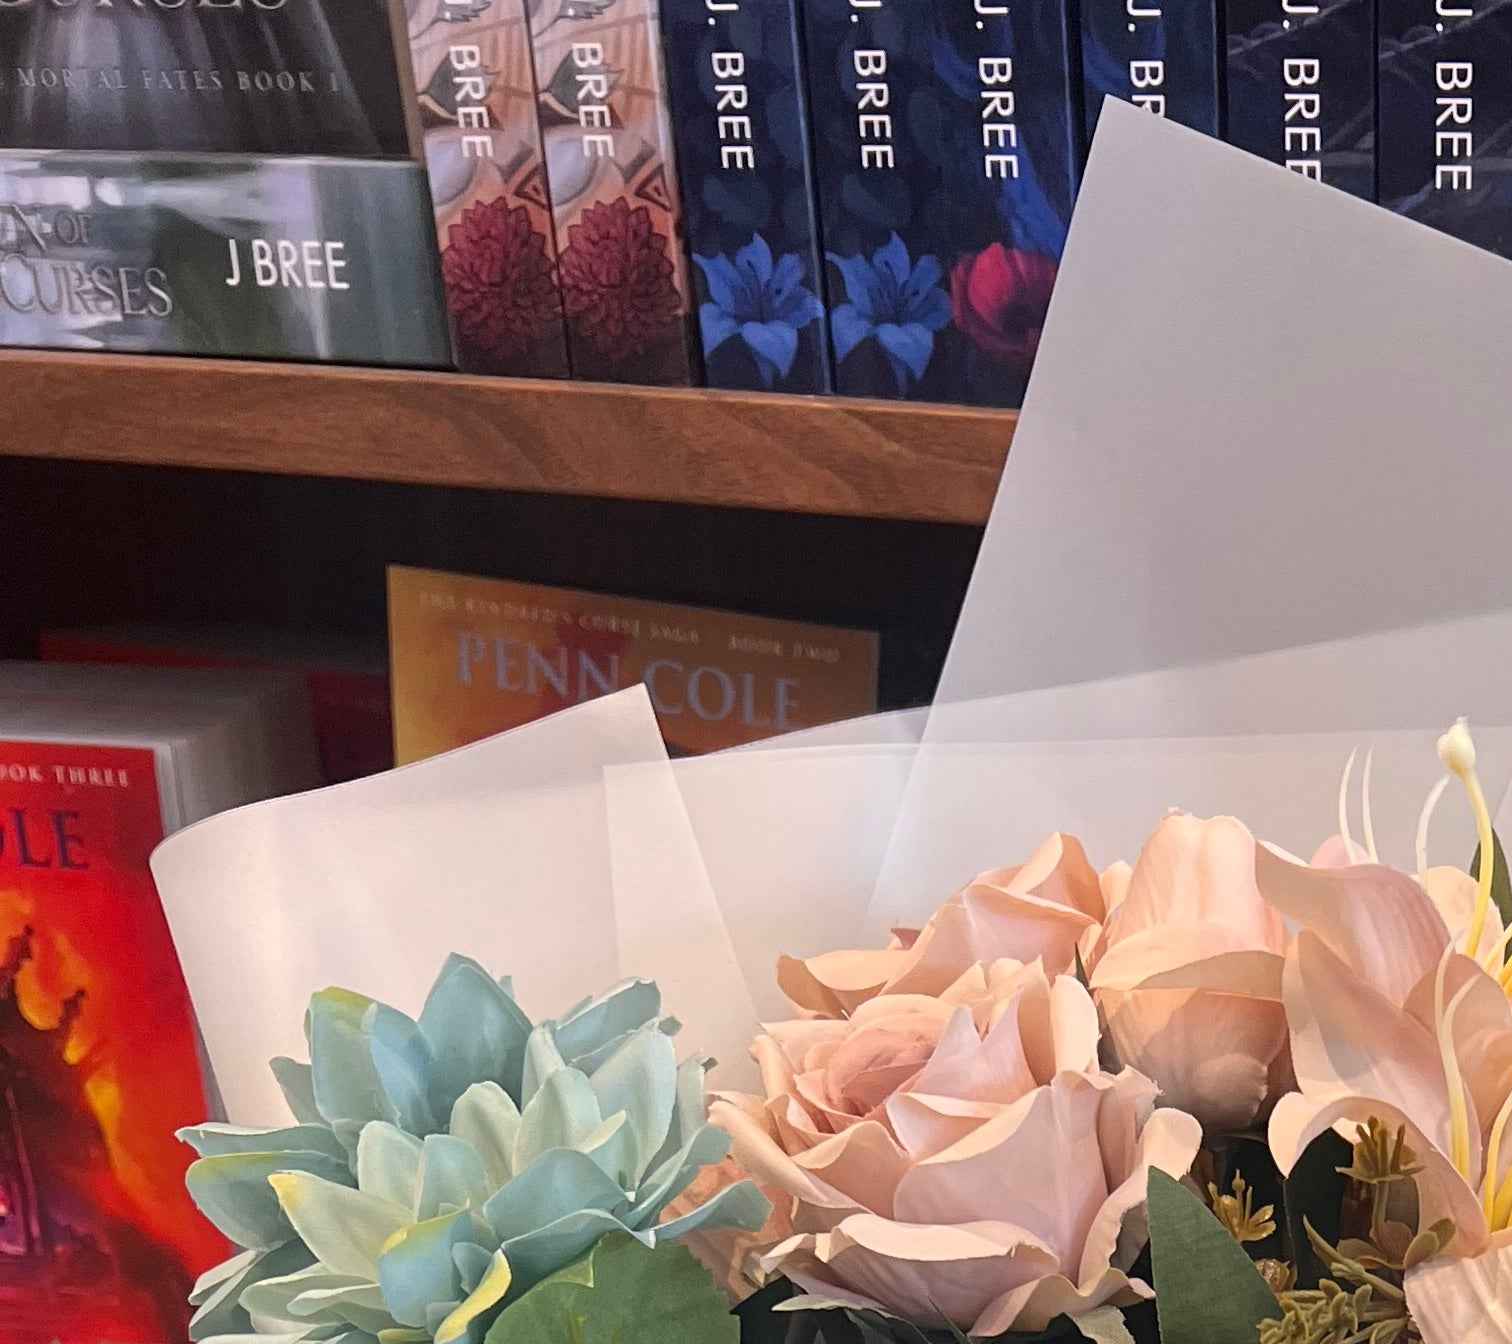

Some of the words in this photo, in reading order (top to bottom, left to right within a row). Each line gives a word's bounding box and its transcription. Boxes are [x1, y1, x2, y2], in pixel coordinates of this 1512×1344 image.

[18, 67, 128, 90] MORTAL
[238, 71, 315, 92] BOOK
[449, 44, 495, 159] BREE
[572, 42, 615, 158] BREE
[711, 51, 755, 169] BREE
[853, 49, 895, 169] BREE
[978, 57, 1018, 179] BREE
[1435, 61, 1473, 190] BREE
[0, 252, 173, 318] CURSES
[226, 238, 240, 286] J
[252, 238, 350, 290] BREE
[455, 629, 620, 700] PENN
[643, 659, 802, 729] COLE
